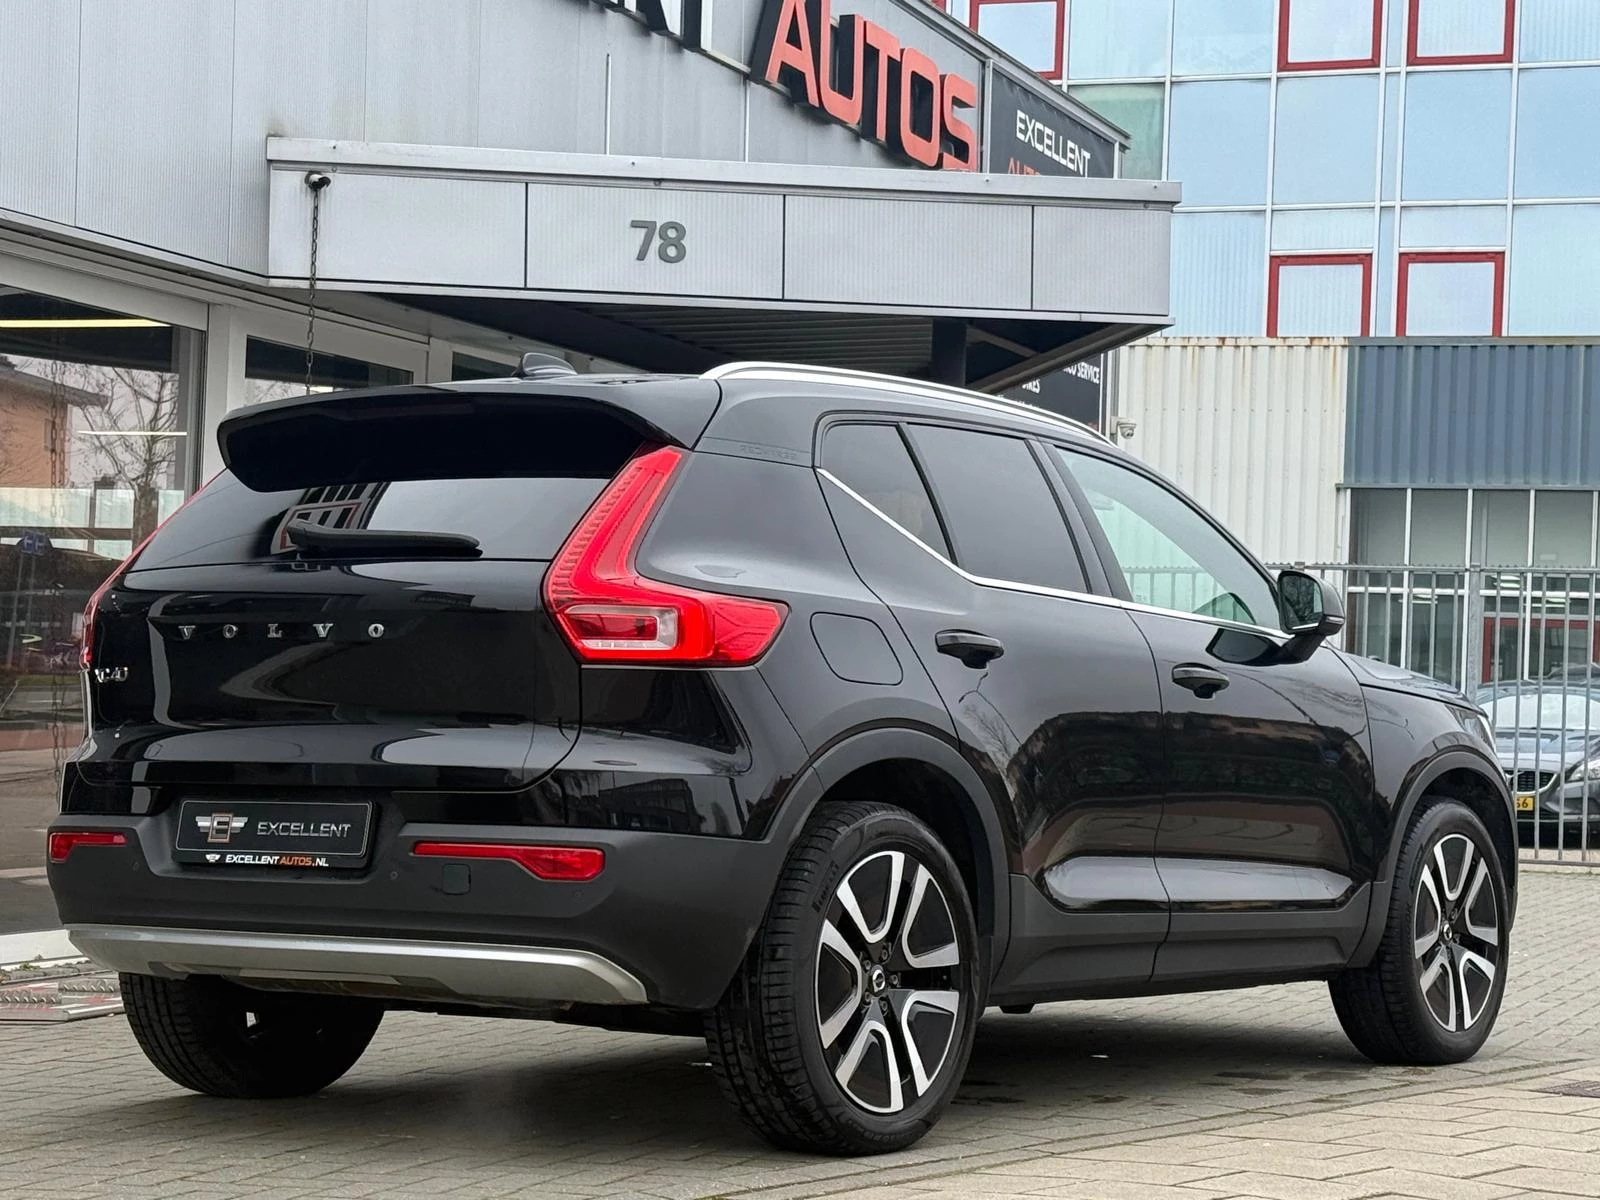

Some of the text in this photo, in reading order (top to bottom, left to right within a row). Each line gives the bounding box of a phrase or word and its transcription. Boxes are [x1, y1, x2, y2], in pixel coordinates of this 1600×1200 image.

[764, 0, 977, 172] AUTOS
[1016, 109, 1091, 178] EXCELLENT
[630, 219, 687, 264] 78
[1077, 361, 1100, 384] SERVICE
[178, 623, 385, 640] VOLVO
[257, 821, 351, 838] EXCELLENT
[225, 853, 329, 868] EXCELLENTAUTOS.NL
